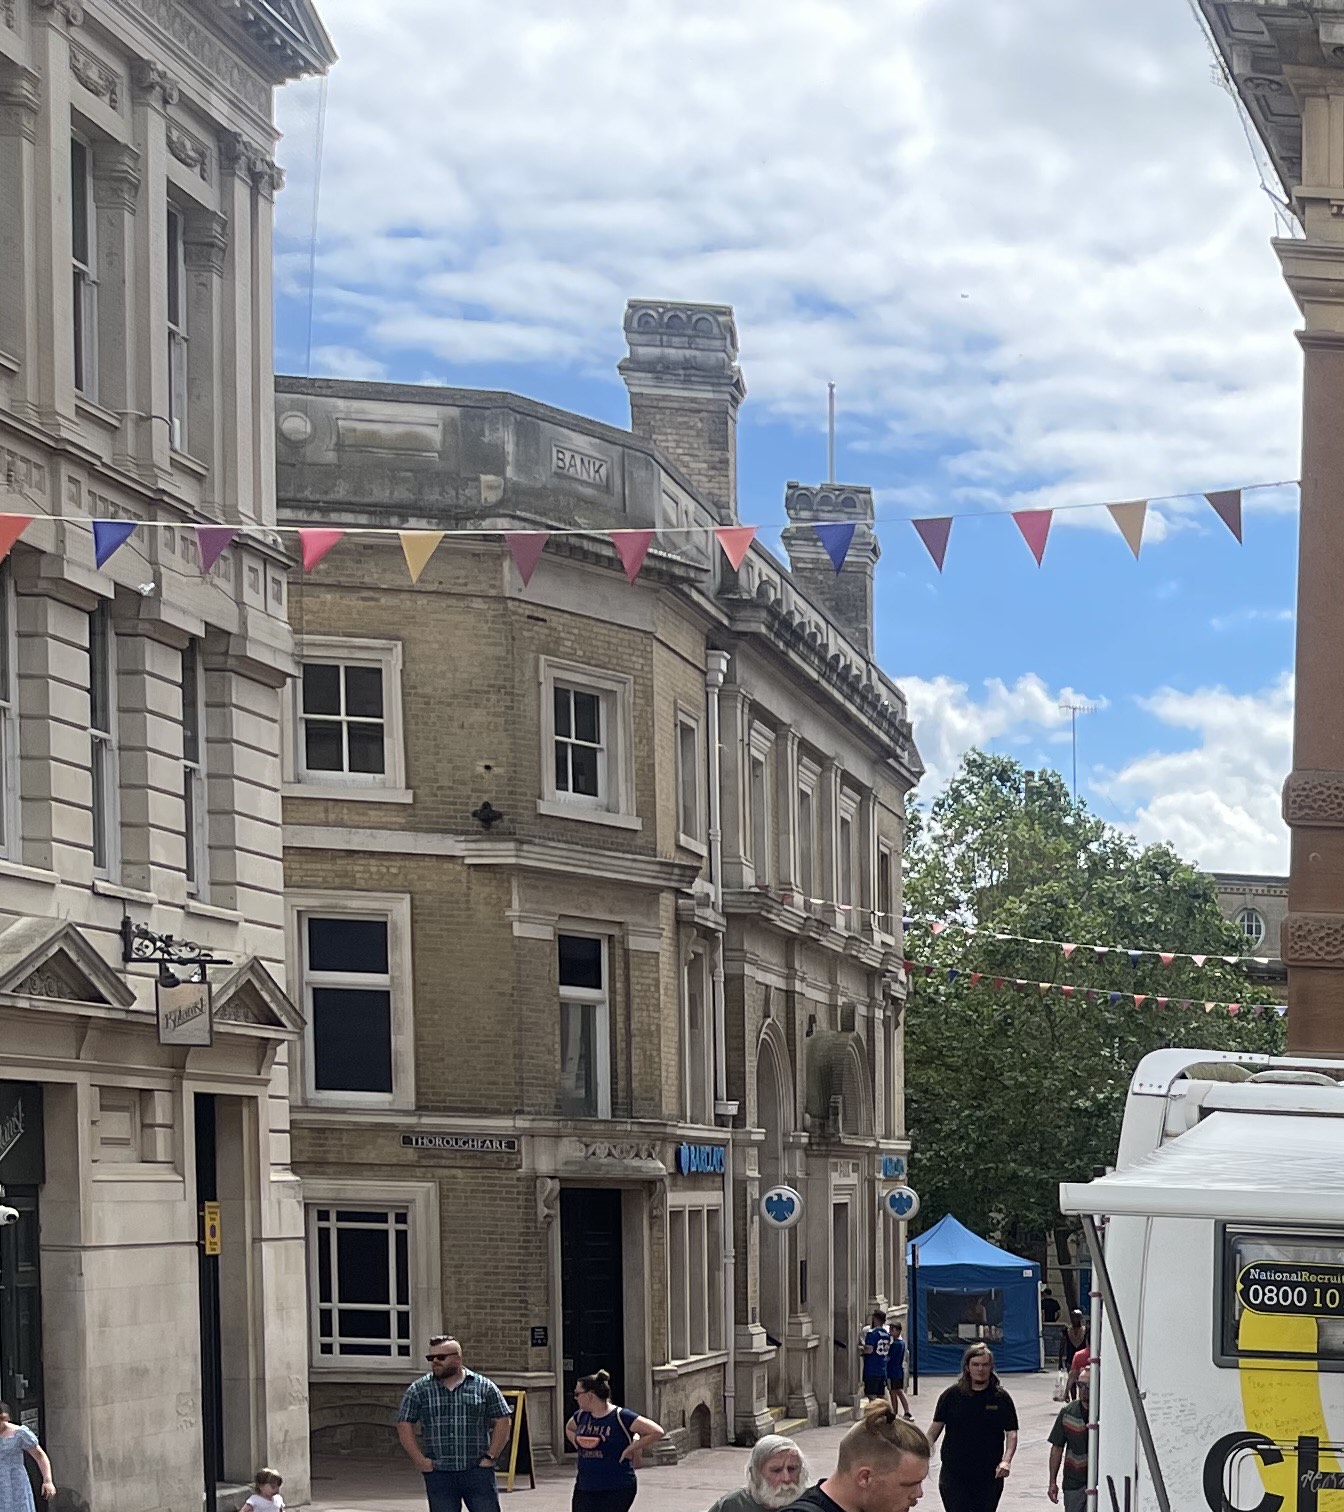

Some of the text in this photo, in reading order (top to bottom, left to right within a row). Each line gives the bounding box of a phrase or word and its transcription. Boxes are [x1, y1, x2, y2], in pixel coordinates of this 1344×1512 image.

[556, 449, 604, 484] BANK
[410, 1135, 509, 1150] THOROUGHFARE
[1249, 1285, 1308, 1306] 0800
